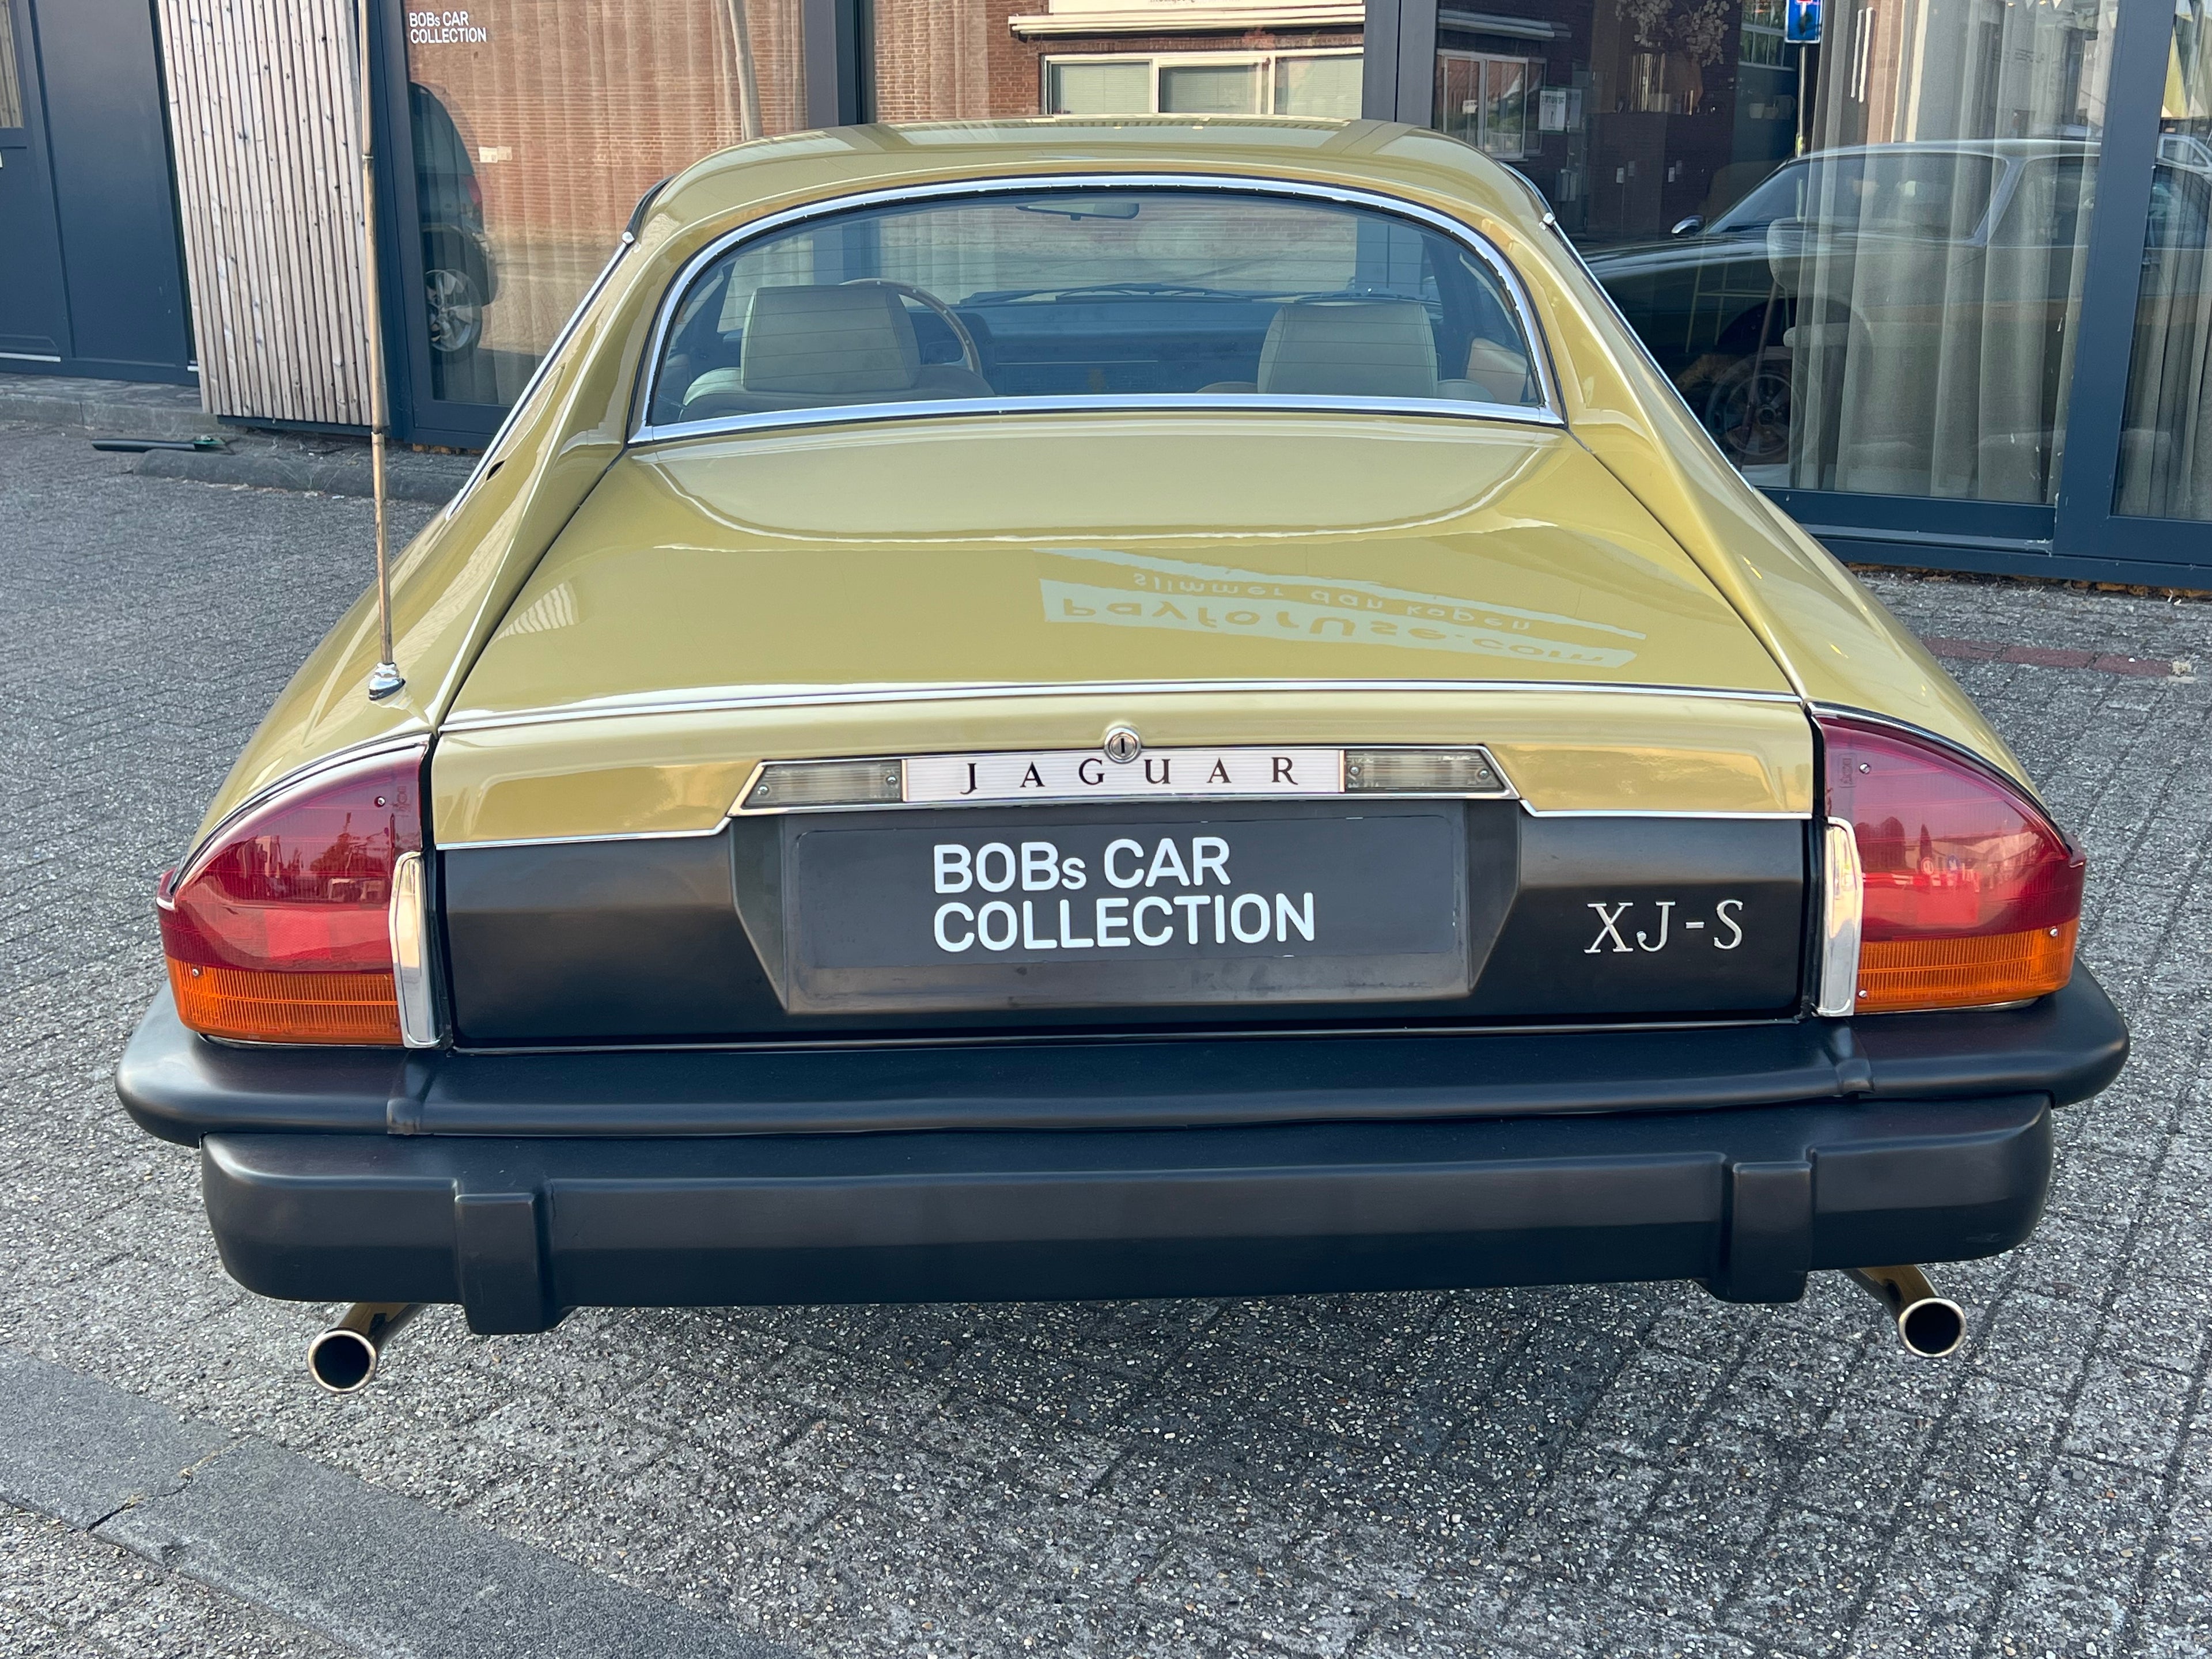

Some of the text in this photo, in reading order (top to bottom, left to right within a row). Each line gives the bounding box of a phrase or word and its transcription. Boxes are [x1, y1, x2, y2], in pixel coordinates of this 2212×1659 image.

[409, 11, 469, 27] BOBs CAR
[410, 27, 487, 44] COLLECTION
[960, 757, 1298, 795] JAGUAR
[933, 836, 1232, 894] BOBs CAR
[933, 892, 1315, 953] COLLECTION
[1584, 899, 1744, 953] XJ-S
